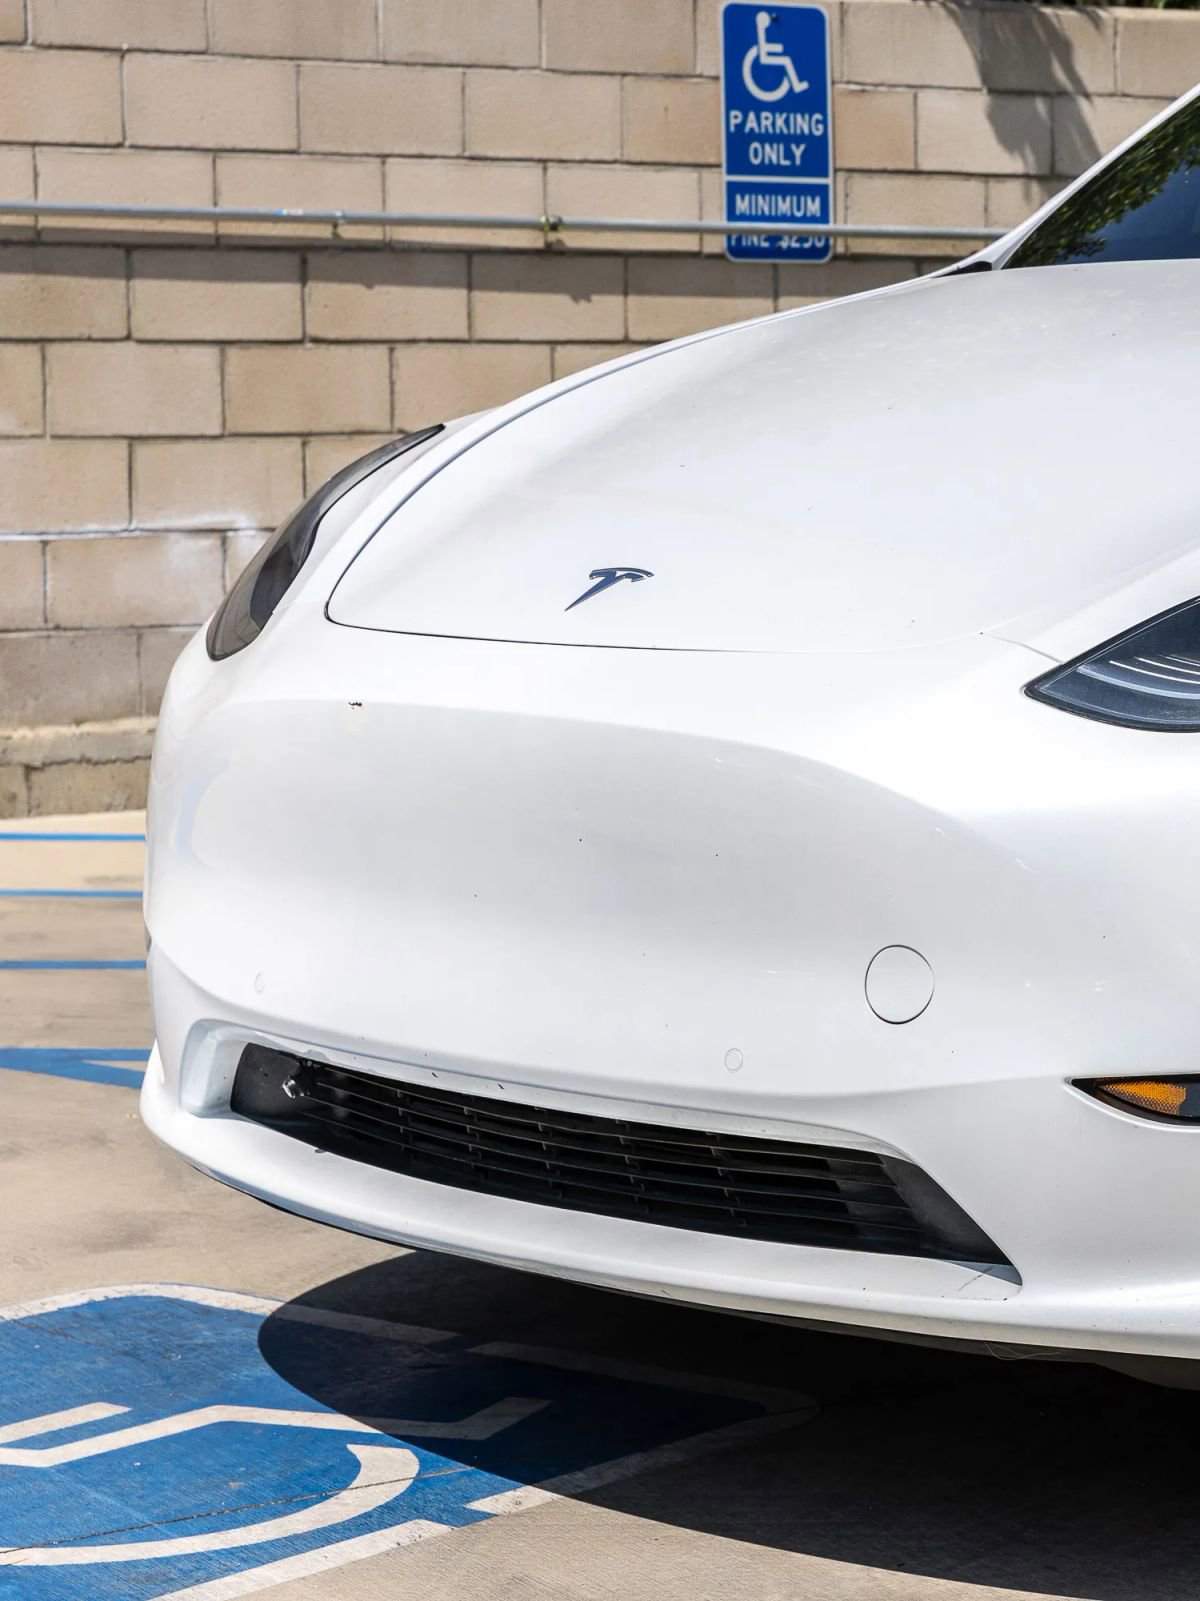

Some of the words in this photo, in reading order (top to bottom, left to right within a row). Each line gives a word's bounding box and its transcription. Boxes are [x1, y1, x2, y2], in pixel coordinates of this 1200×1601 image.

[729, 110, 825, 136] PARKING
[749, 142, 806, 166] ONLY
[735, 193, 821, 217] MINIMUM
